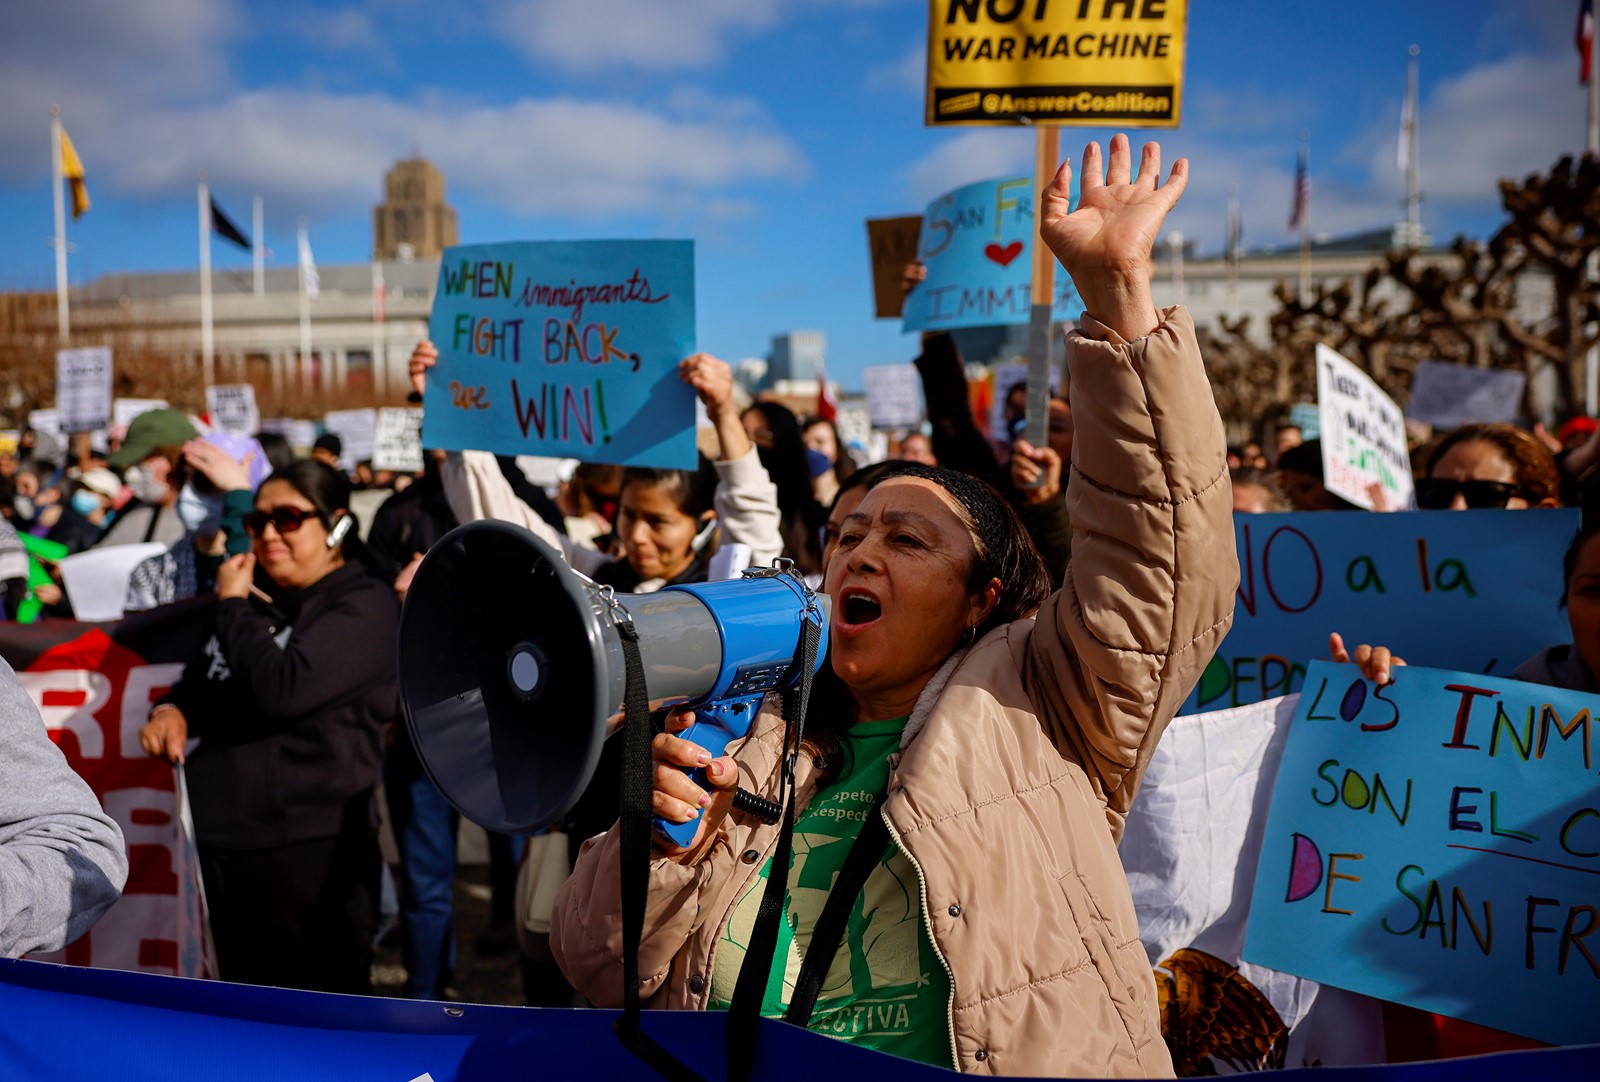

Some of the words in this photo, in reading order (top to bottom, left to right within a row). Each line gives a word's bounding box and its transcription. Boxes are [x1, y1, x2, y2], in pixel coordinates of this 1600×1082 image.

[946, 0, 1050, 24] NOT
[1077, 0, 1168, 20] THE
[943, 37, 1015, 61] WAR
[1022, 33, 1172, 60] MACHINE
[982, 91, 1170, 113] @AnswerCoalition
[444, 258, 513, 299] WHEN
[517, 267, 669, 323] immigrants
[454, 314, 524, 363] FIGHT
[543, 318, 641, 373] BACK,
[449, 380, 491, 411] we
[511, 378, 611, 445] WIN!
[1346, 555, 1387, 594] a
[1416, 538, 1477, 598] la
[1306, 677, 1399, 732] LOS
[1442, 684, 1600, 775] INM
[1312, 759, 1412, 826] SON
[1449, 786, 1540, 844] EL
[1285, 832, 1364, 915] DE
[1381, 864, 1492, 956] SAN
